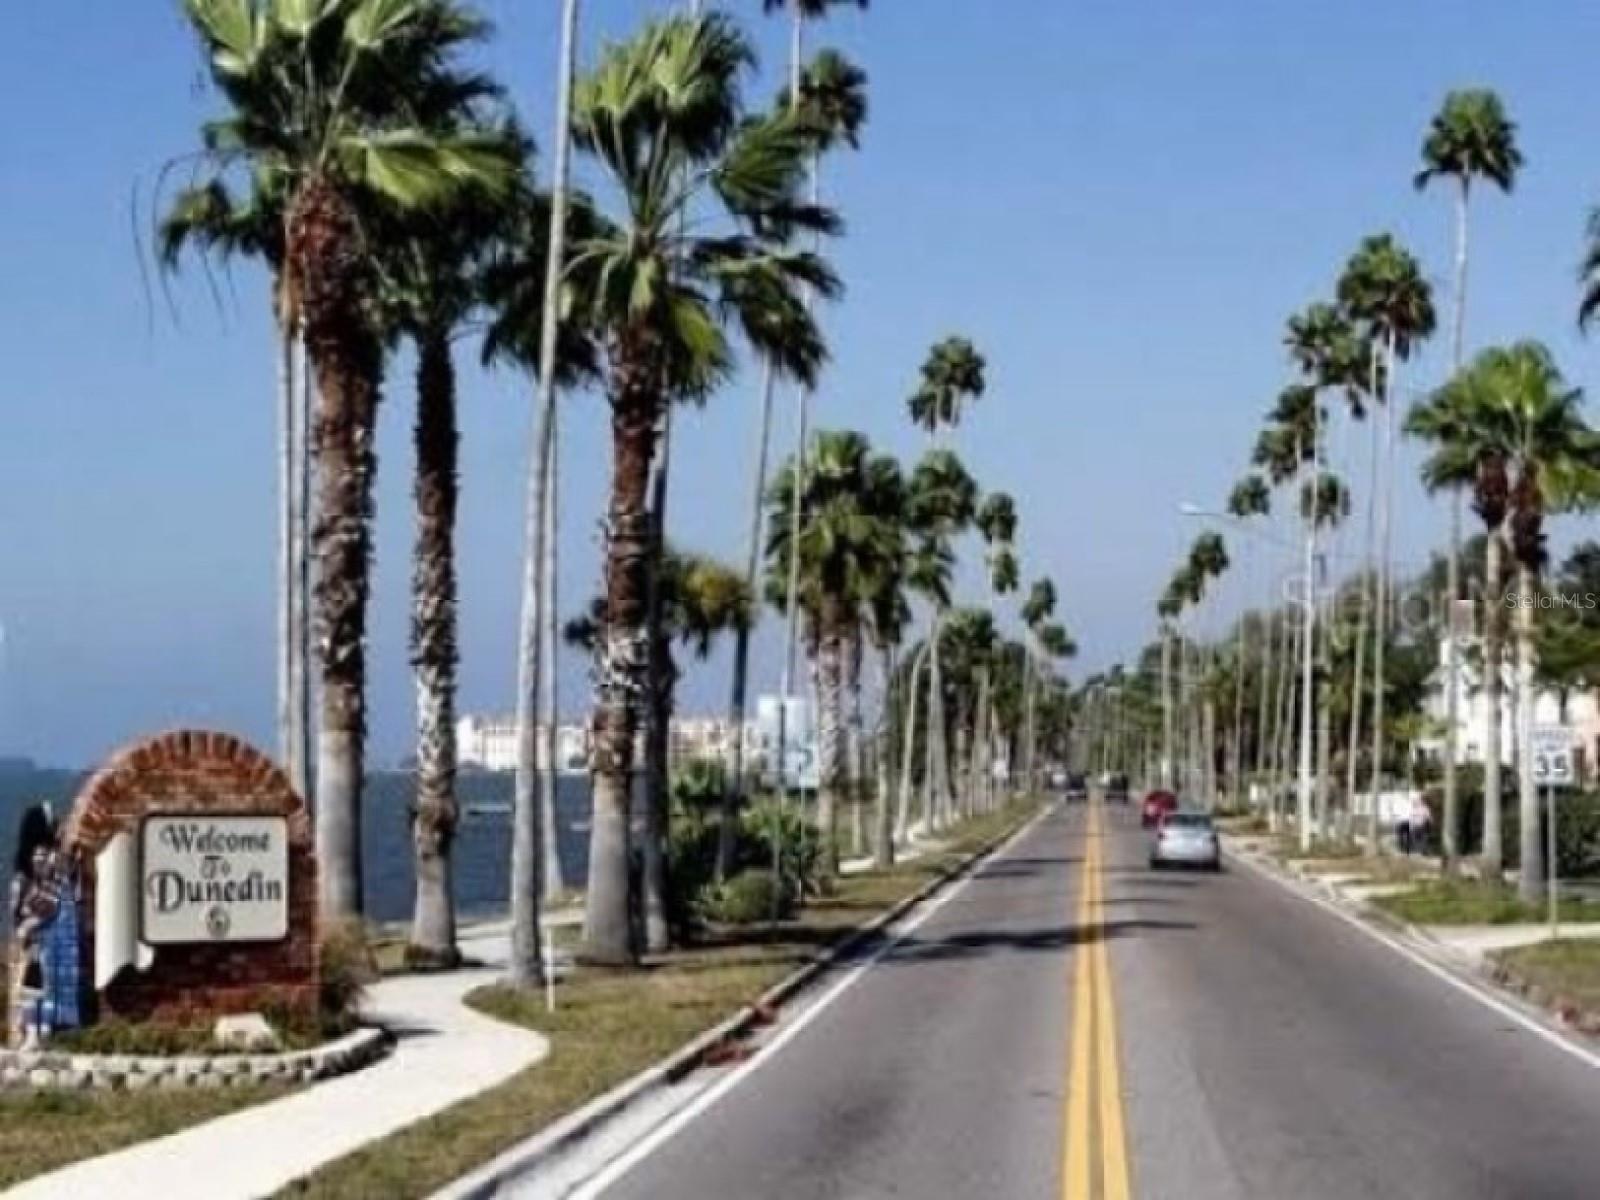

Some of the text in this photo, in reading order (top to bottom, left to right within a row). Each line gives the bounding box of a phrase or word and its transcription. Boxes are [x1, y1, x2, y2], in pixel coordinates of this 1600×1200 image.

[159, 824, 270, 852] Welcome
[201, 855, 231, 880] To
[148, 869, 281, 914] Dunedin
